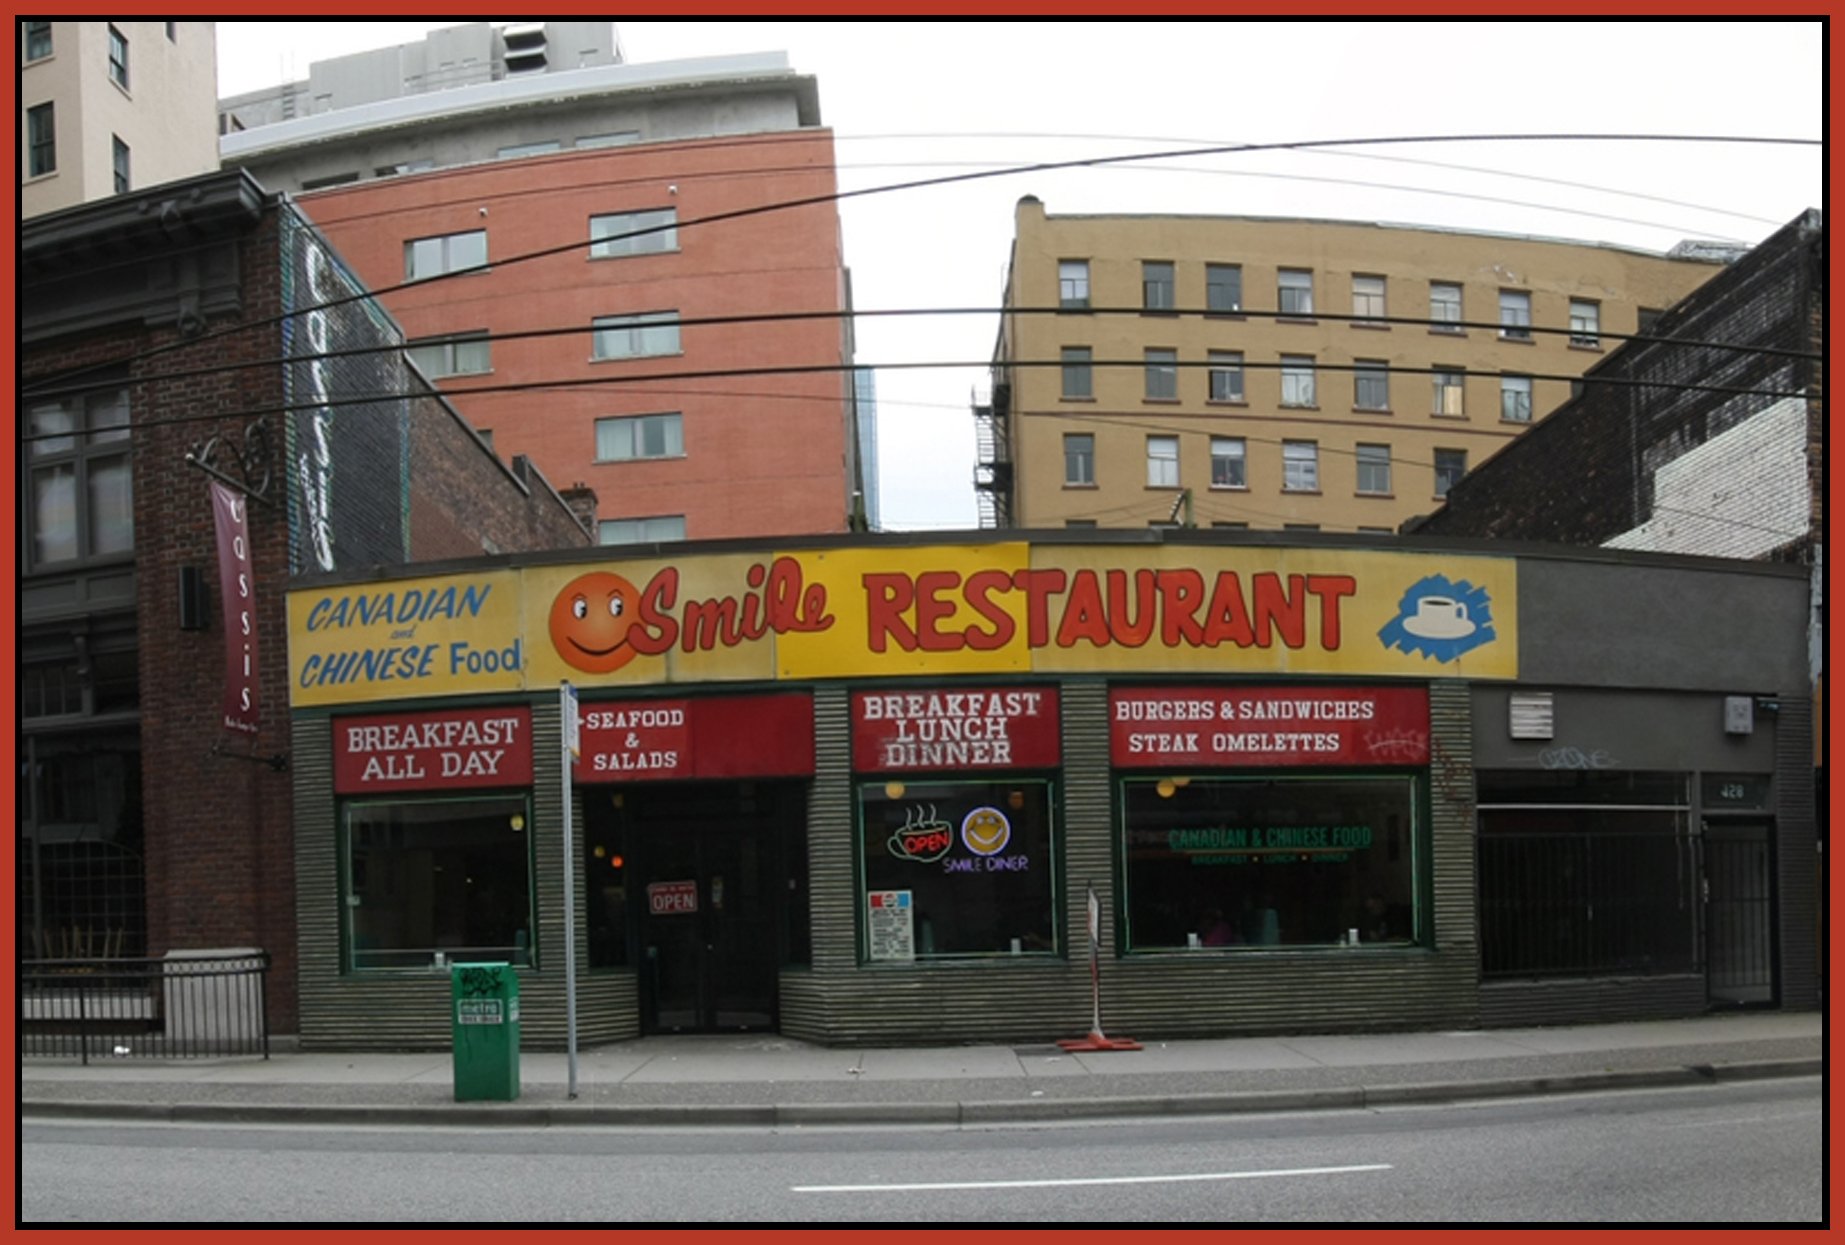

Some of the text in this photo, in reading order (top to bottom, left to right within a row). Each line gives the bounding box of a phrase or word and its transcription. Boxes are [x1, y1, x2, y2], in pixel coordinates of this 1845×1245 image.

[306, 584, 492, 632] CANADIAN
[627, 556, 1357, 656] Smile RESTAURANT
[300, 638, 521, 688] CHINESE Food
[862, 692, 1041, 720] BREAKFAST
[1115, 701, 1375, 721] BURGERS & SANDWICHES
[586, 709, 684, 730] SEAFOOD
[896, 717, 1008, 743] LUNCH
[347, 718, 519, 753] BREAKFAST
[624, 732, 640, 748] &
[1129, 733, 1199, 752] STEAK
[1212, 733, 1340, 751] OMELETTES
[361, 750, 505, 781] ALL DAY
[593, 751, 678, 771] SALADS
[885, 741, 1012, 767] DINNER
[904, 831, 949, 854] OPEN
[1168, 826, 1373, 850] CANADIAN & CHINESE FOOD
[942, 855, 1029, 873] SMILE DINER
[653, 893, 694, 910] OPEN
